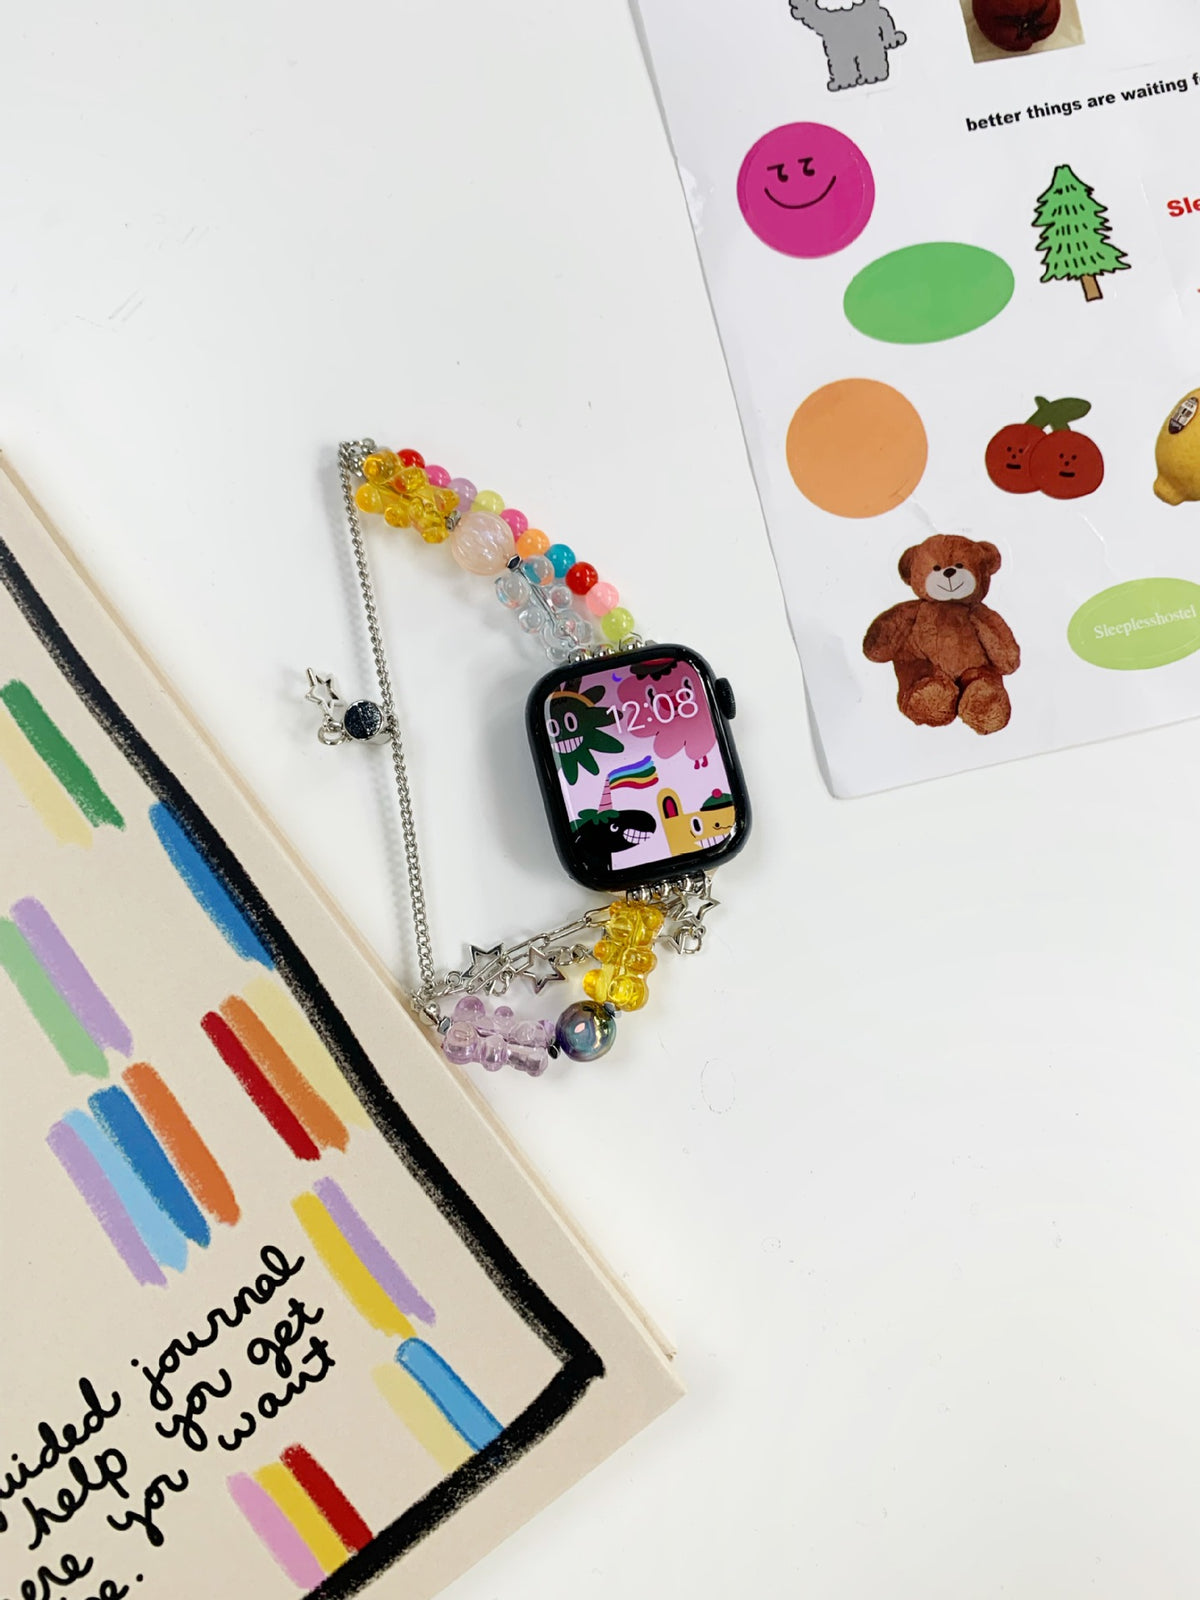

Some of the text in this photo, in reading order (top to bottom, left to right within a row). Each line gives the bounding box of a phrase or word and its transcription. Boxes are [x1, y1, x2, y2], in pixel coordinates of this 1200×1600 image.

[965, 111, 1022, 132] better
[1026, 102, 1083, 119] things
[1087, 93, 1116, 108] are
[1120, 78, 1188, 101] waiting
[1094, 604, 1197, 639] Sleeplesshostel
[606, 687, 699, 734] 12:08
[0, 1245, 305, 1532] uided journal
[22, 1298, 324, 1550] help you get
[3, 1336, 336, 1600] ere you want
